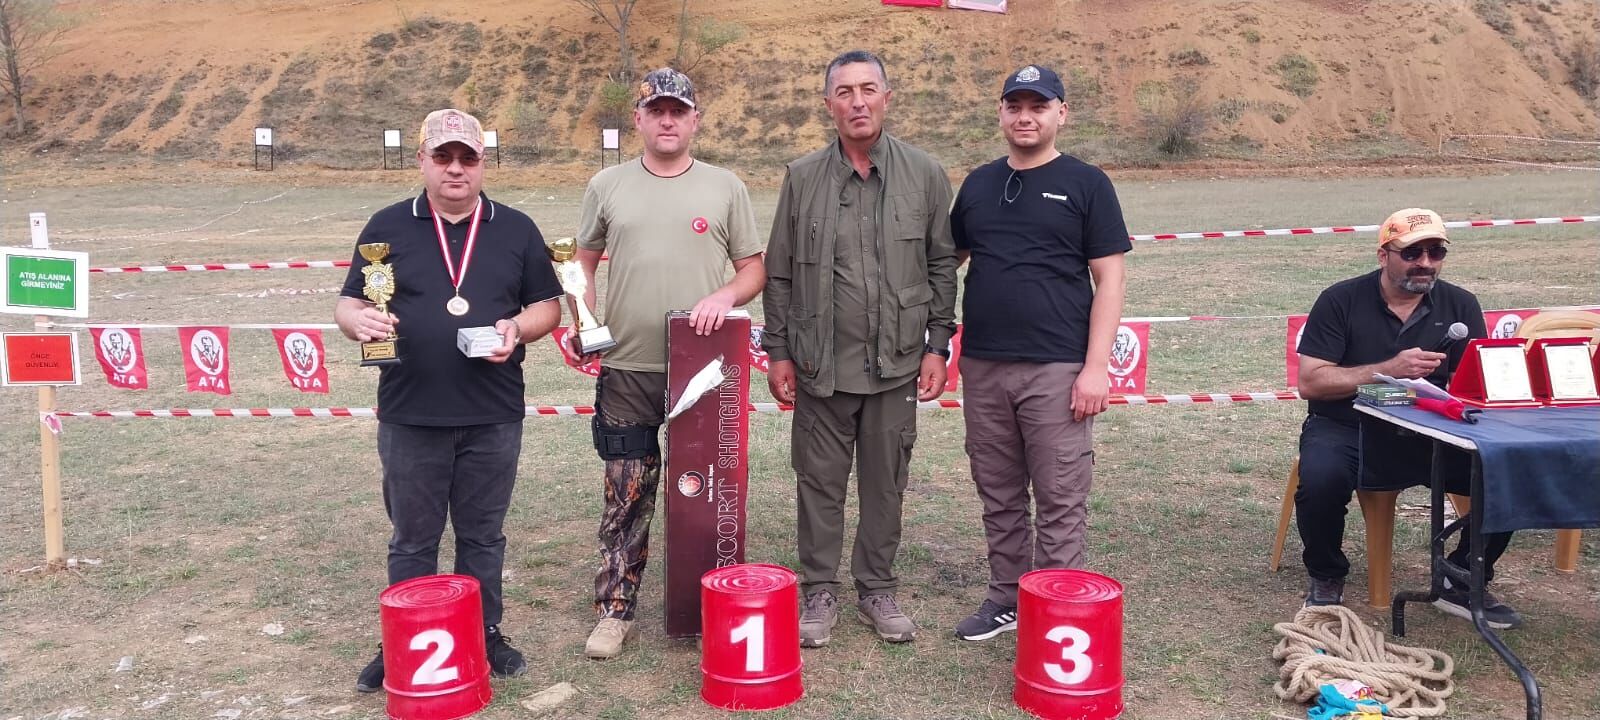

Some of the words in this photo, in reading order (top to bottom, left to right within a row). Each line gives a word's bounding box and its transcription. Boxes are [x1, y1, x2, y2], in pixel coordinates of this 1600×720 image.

[19, 271, 37, 281] ATIŞ
[38, 273, 72, 282] ALANINA
[21, 280, 65, 289] GİRMEYİNİZ
[113, 372, 139, 385] ATA
[752, 355, 769, 369] TA
[198, 376, 225, 389] ATA
[718, 364, 741, 469] SHOTGUNS
[716, 478, 739, 568] SCORT
[408, 628, 459, 686] 2
[729, 614, 766, 672] 1
[1042, 625, 1093, 685] 3
